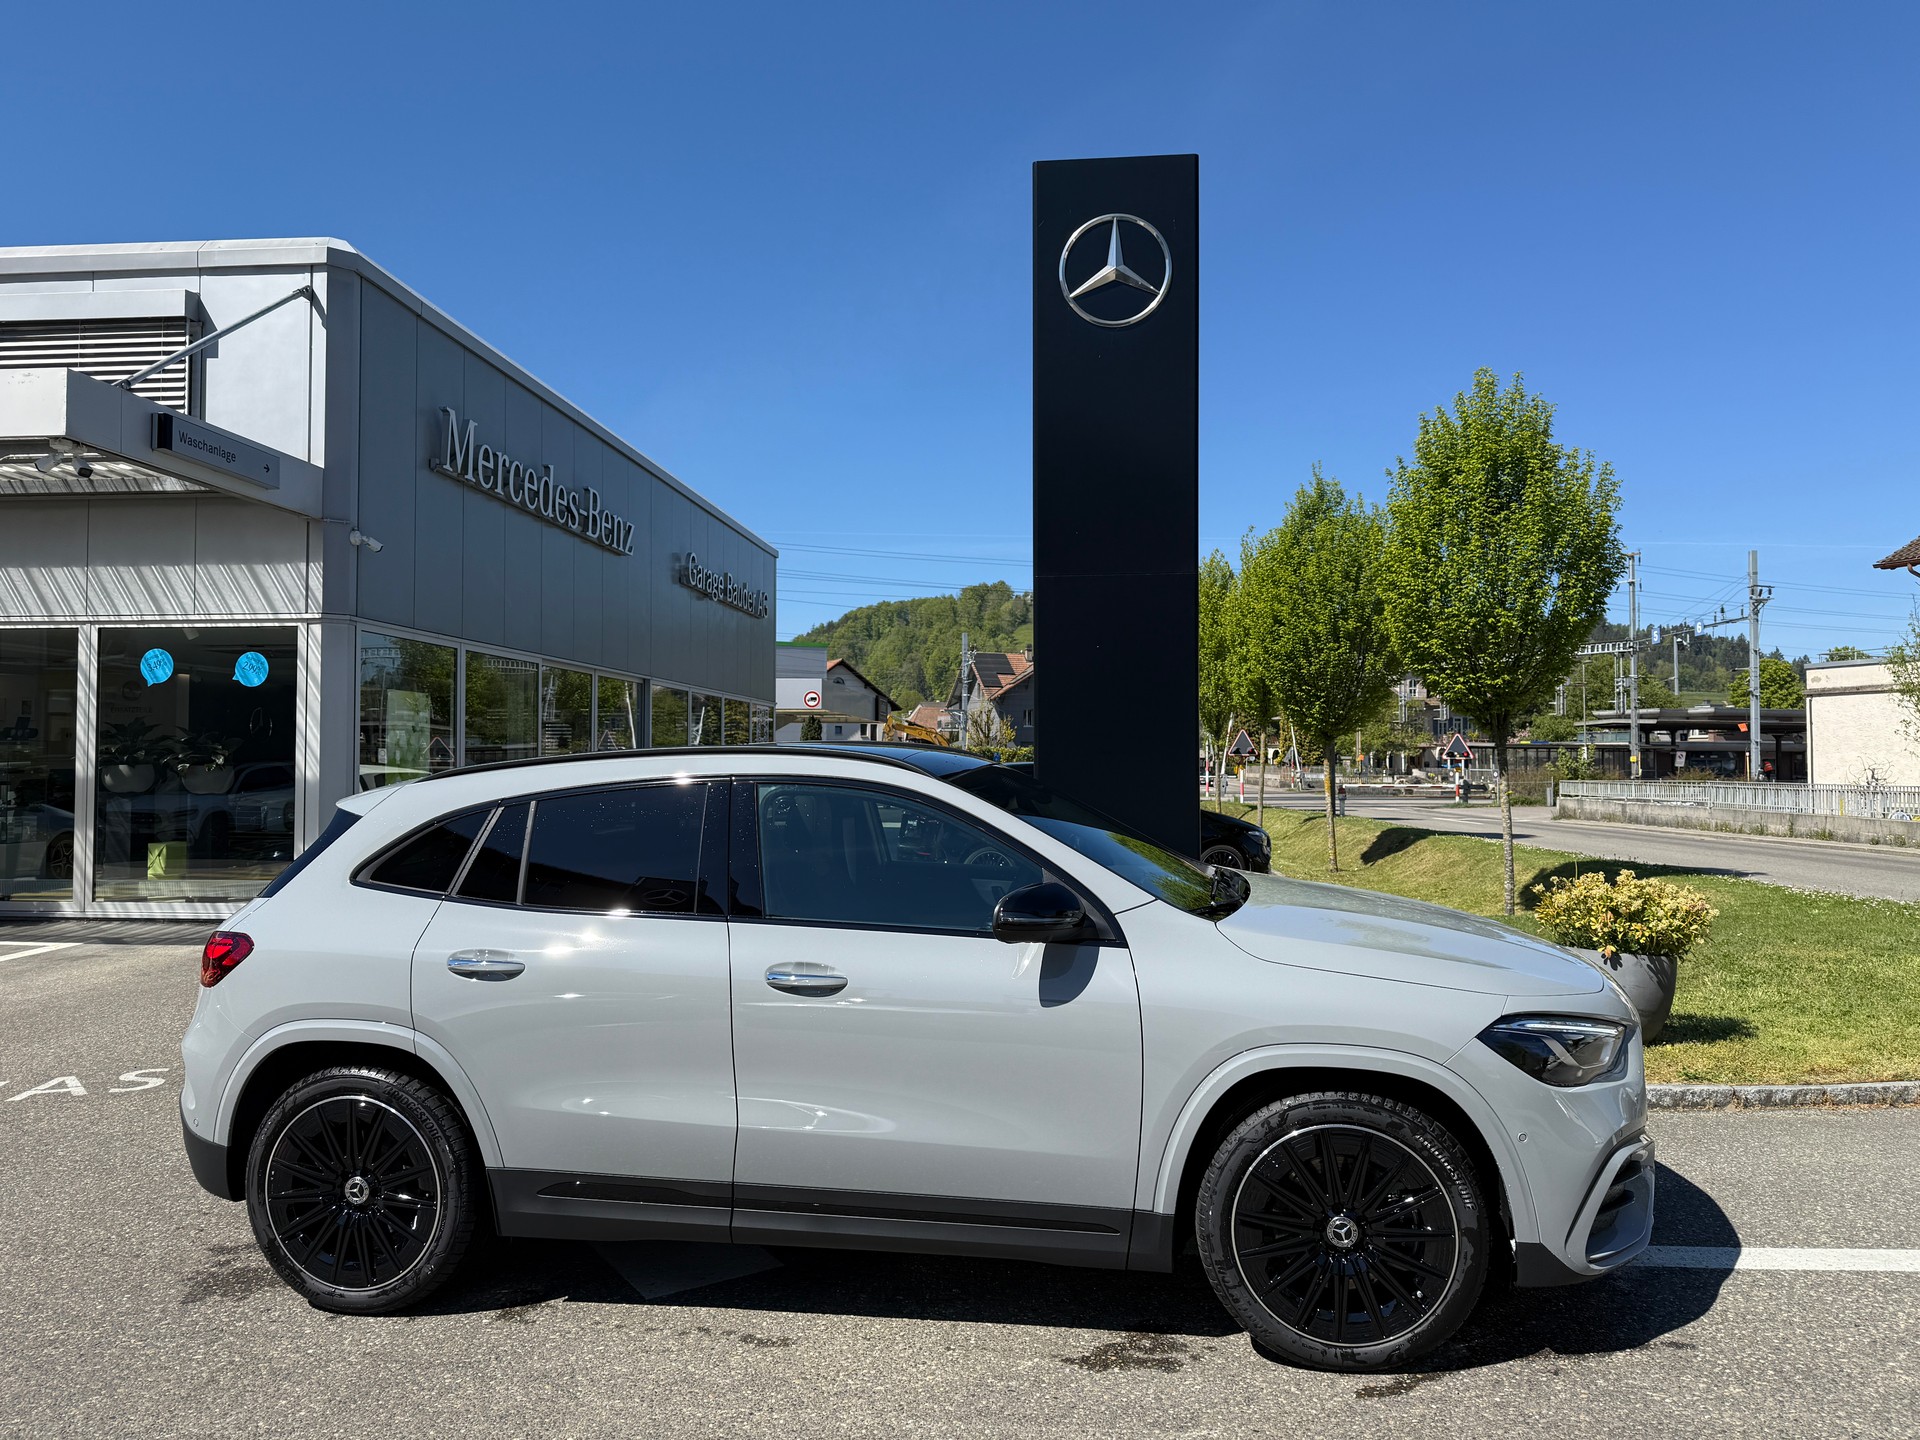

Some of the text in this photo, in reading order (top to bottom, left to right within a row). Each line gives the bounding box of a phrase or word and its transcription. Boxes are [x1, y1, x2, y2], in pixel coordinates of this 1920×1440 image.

[178, 429, 237, 463] Waschanlage
[440, 405, 636, 557] Mercedes-Benz
[685, 551, 769, 619] Garage Bauder AG
[1653, 630, 1659, 642] 5
[1696, 621, 1702, 634] 6
